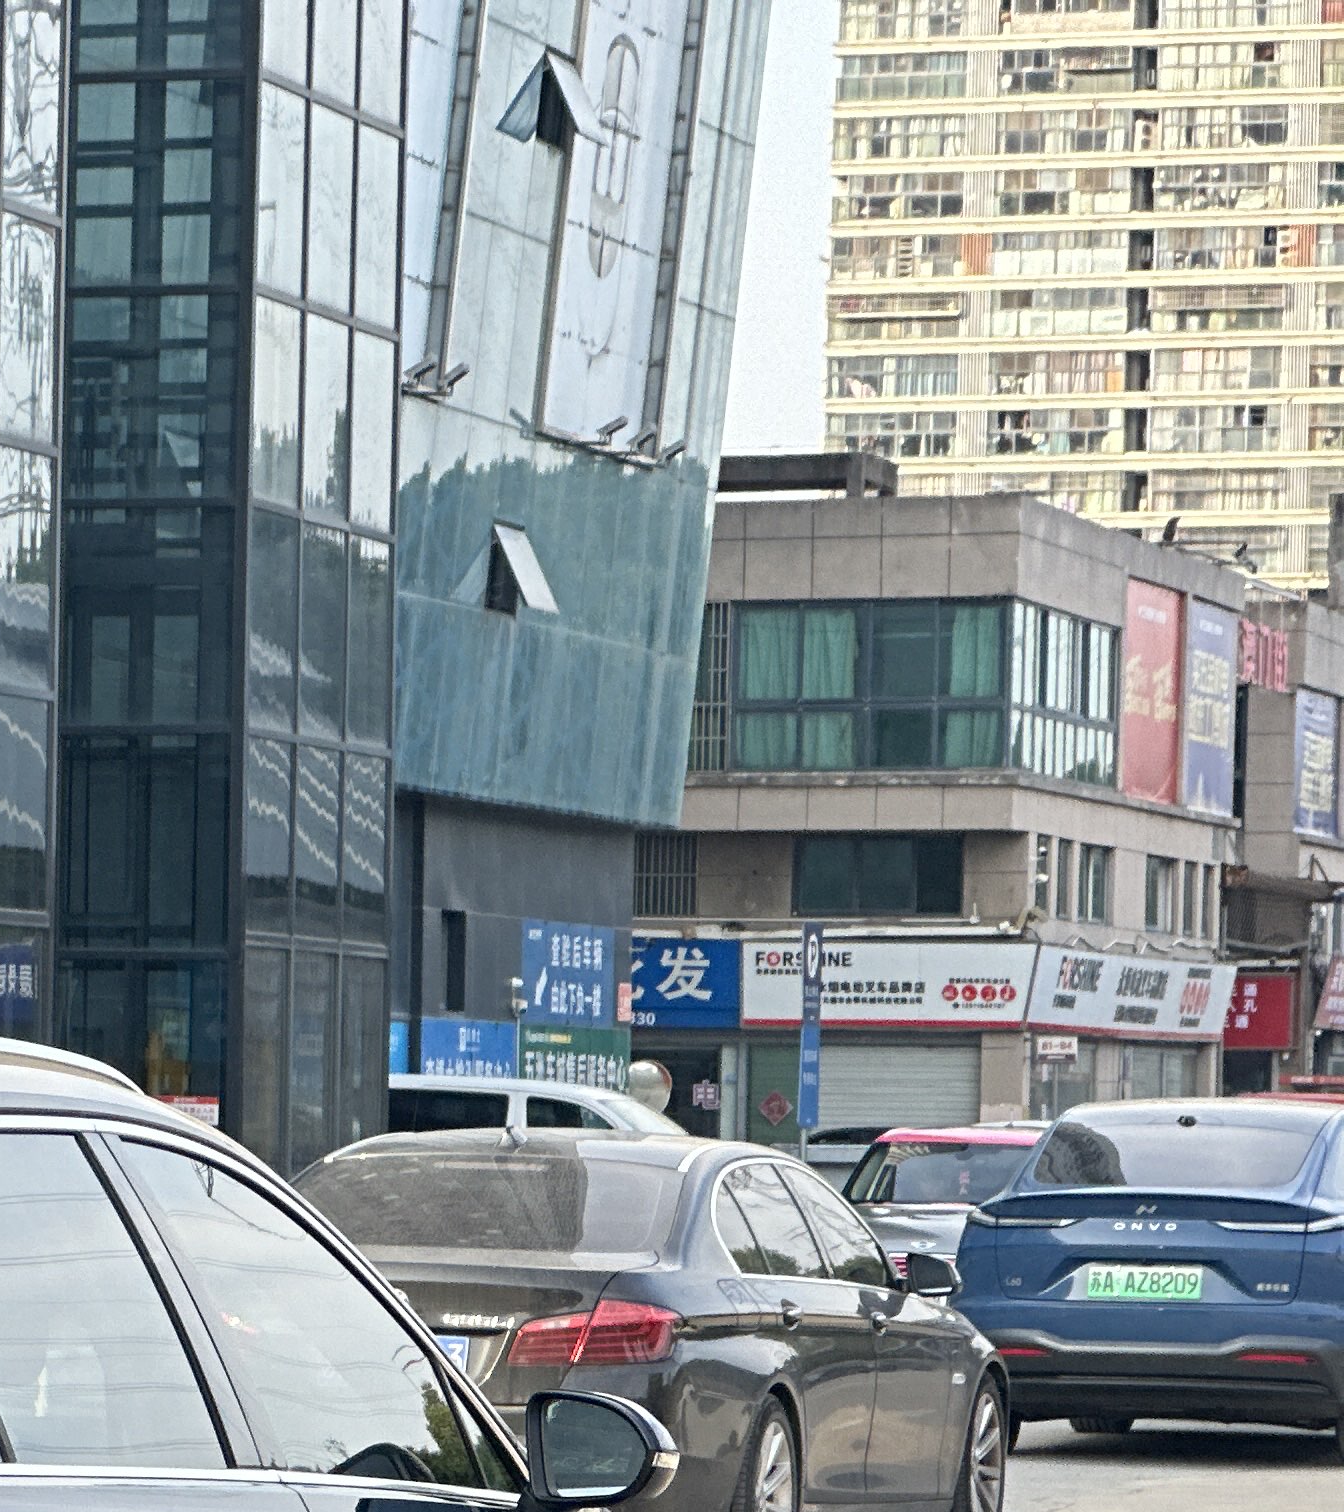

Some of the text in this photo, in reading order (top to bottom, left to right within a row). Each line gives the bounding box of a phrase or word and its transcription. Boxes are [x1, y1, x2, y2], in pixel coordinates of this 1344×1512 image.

[756, 951, 852, 968] FORSINE
[1113, 1221, 1177, 1231] ONVO
[1124, 1271, 1199, 1294] AZ8209
